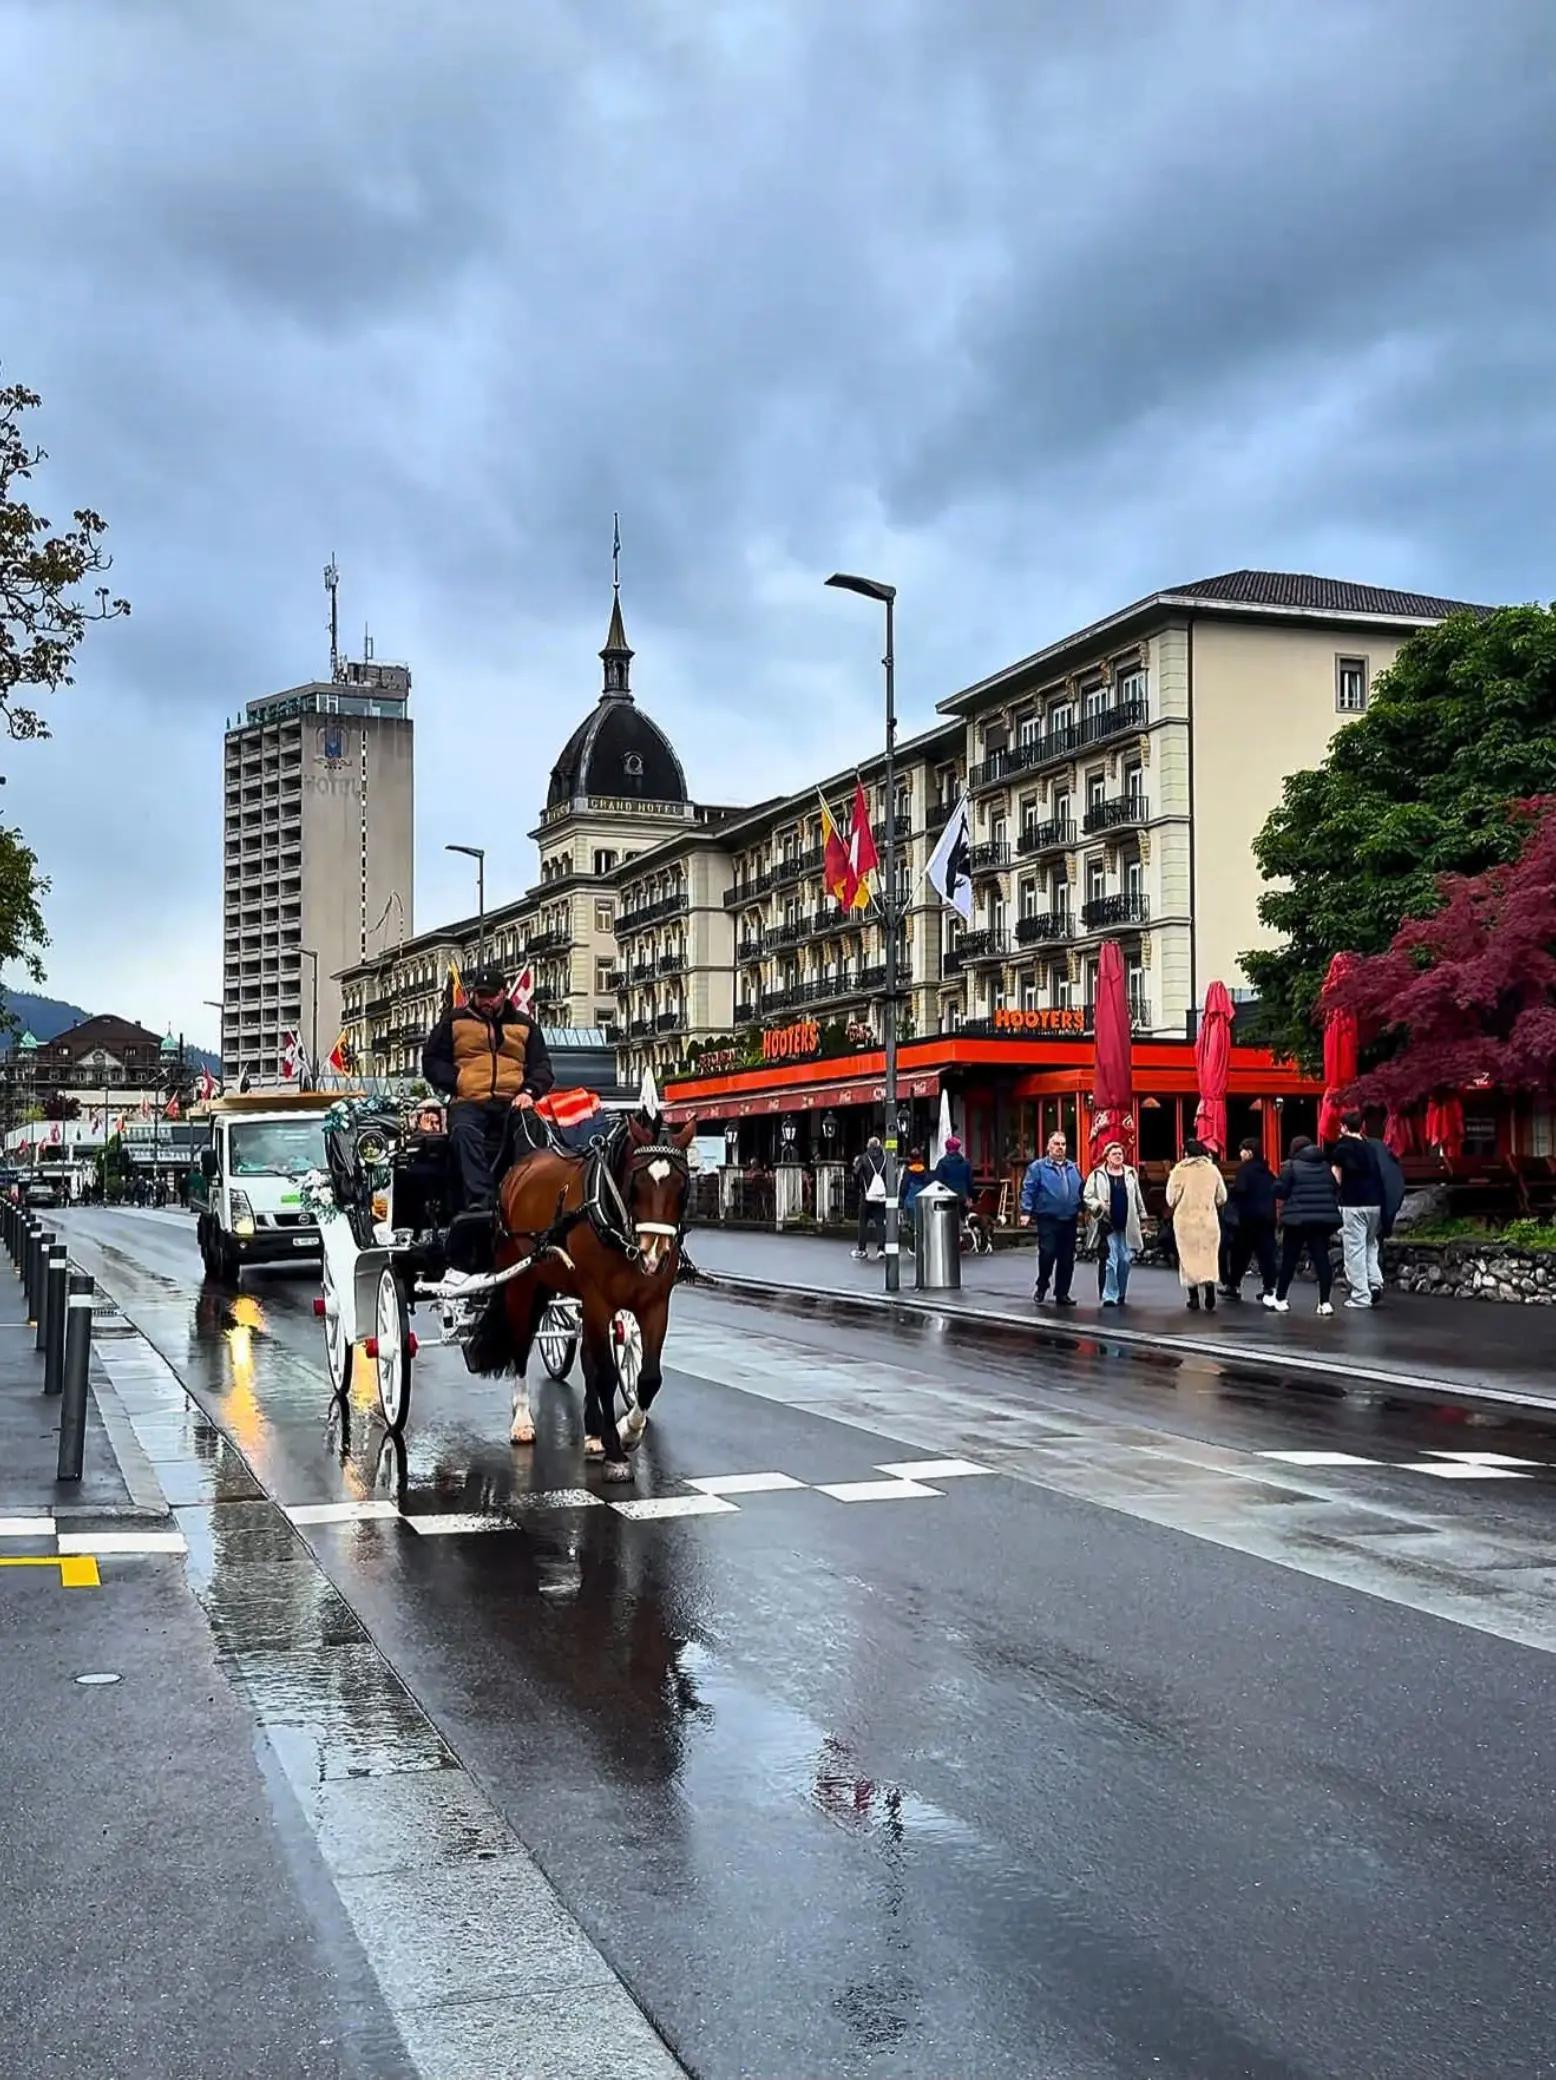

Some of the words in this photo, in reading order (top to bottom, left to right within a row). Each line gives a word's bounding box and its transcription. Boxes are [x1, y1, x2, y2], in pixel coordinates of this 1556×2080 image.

[304, 774, 360, 797] HOTEL
[590, 798, 633, 811] GRAND
[637, 801, 678, 815] HOTEL
[995, 1009, 1085, 1029] HOOTERS
[763, 1023, 818, 1058] HOOTERS
